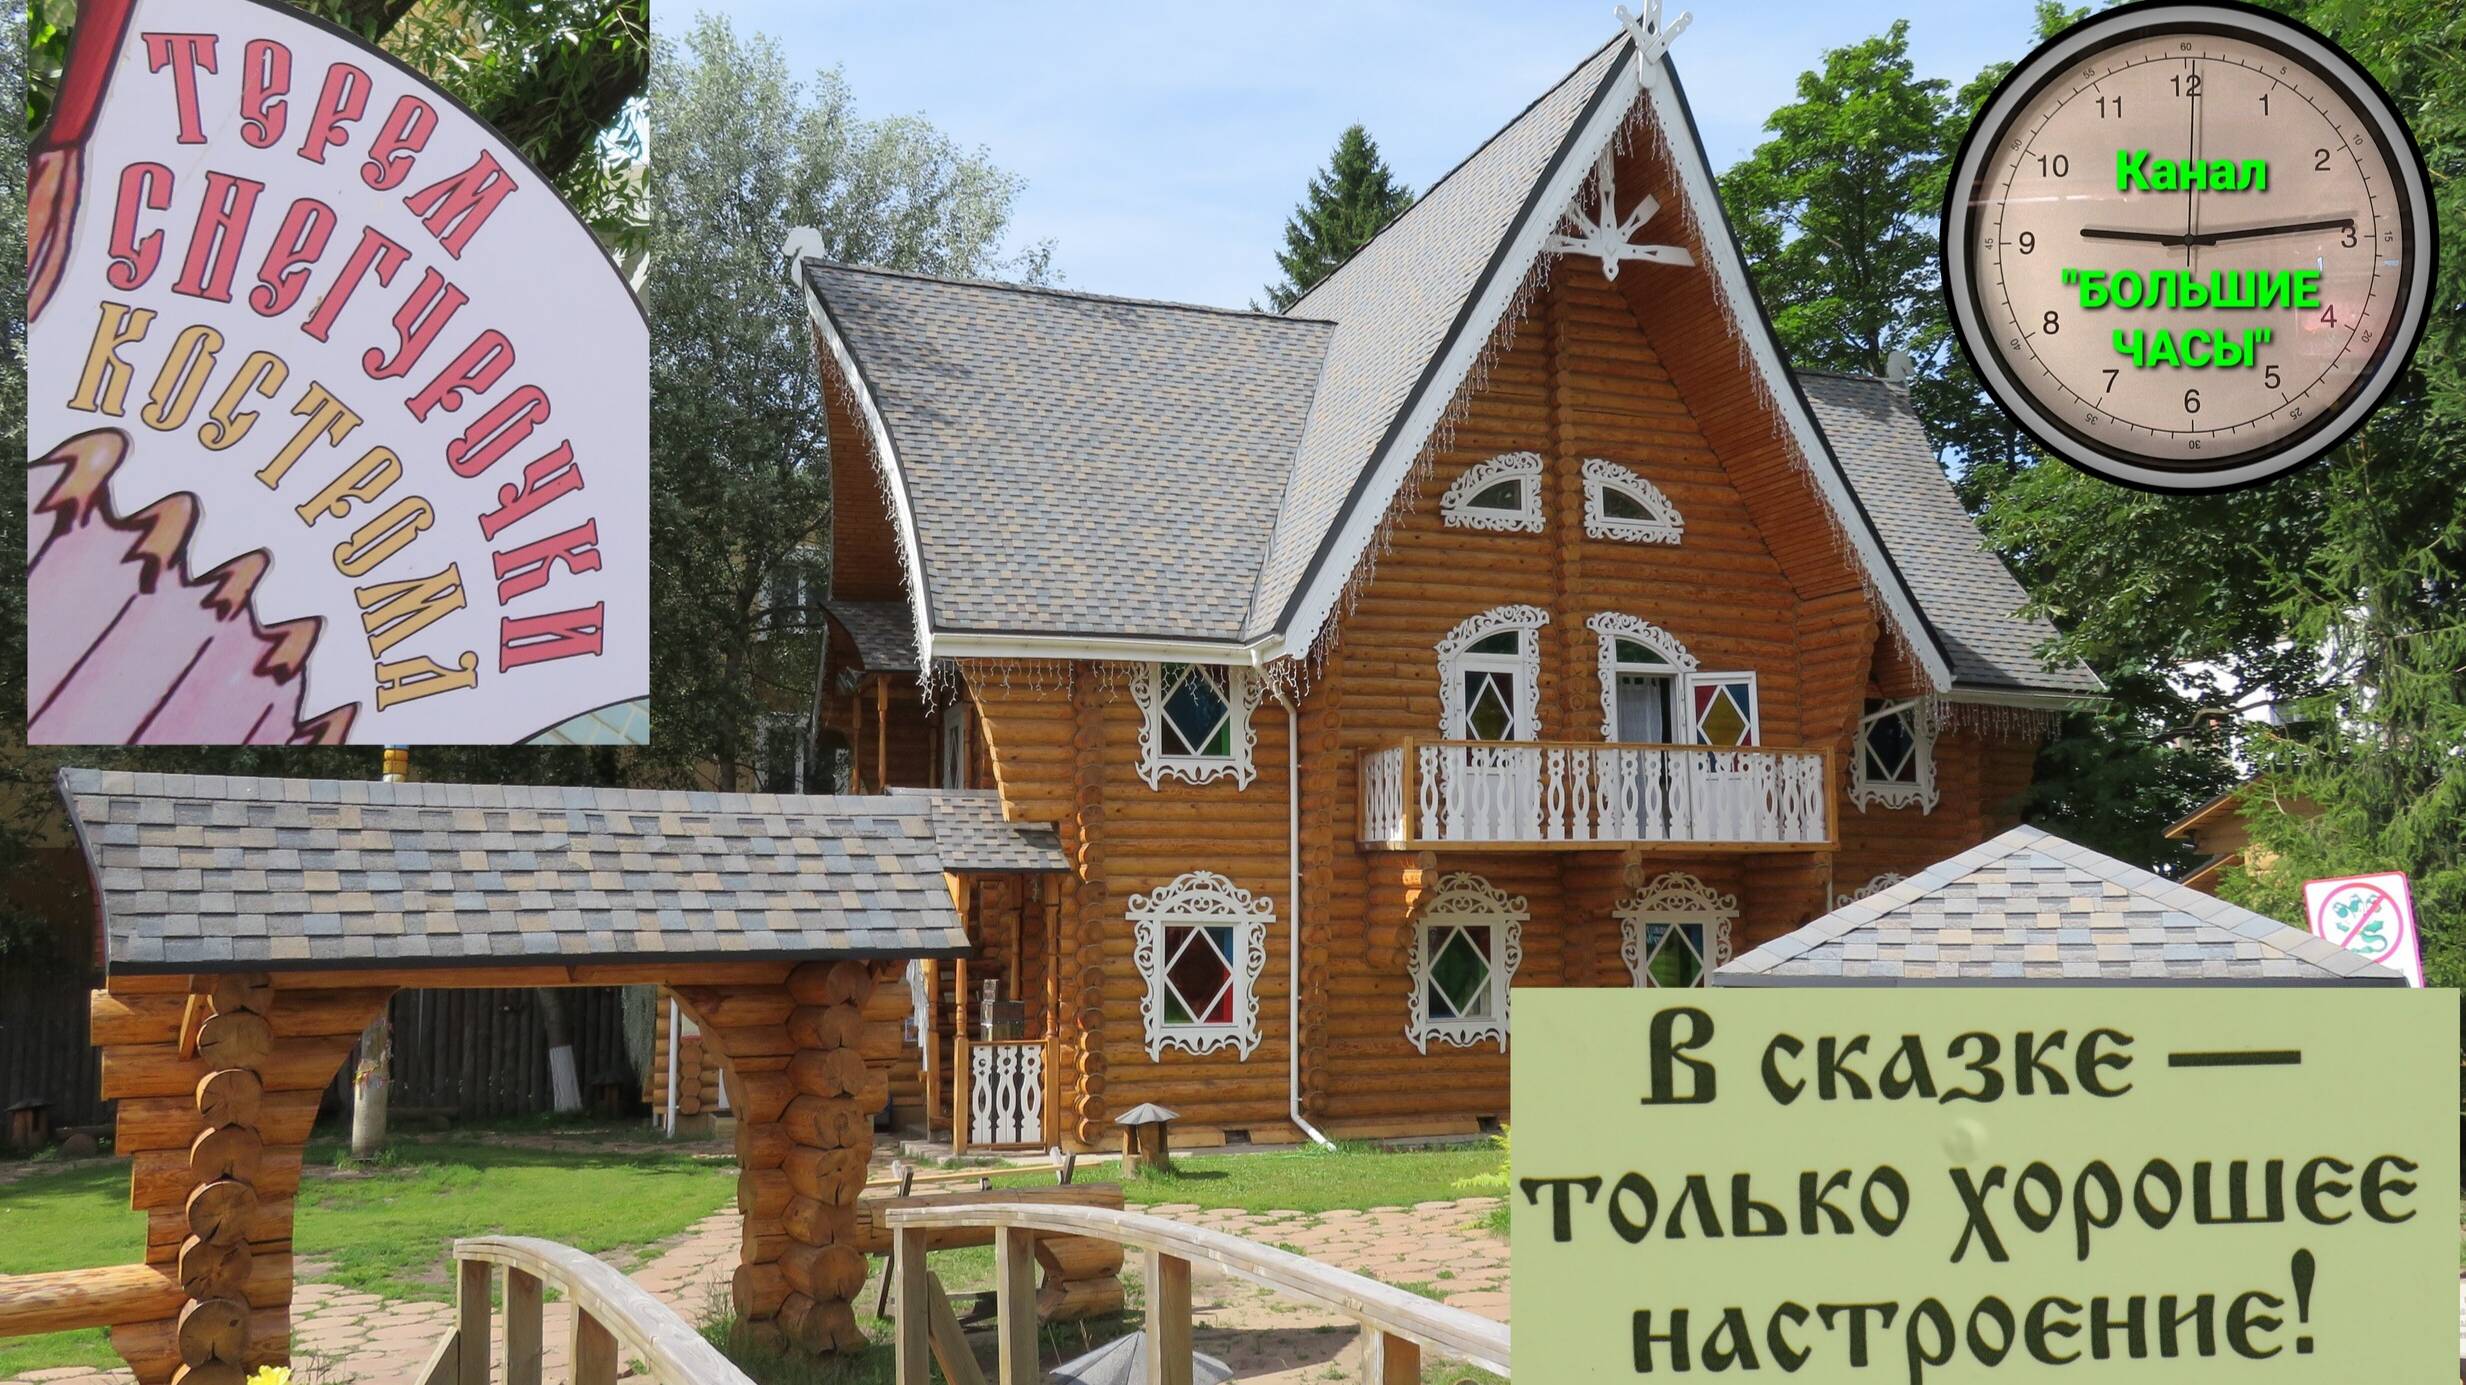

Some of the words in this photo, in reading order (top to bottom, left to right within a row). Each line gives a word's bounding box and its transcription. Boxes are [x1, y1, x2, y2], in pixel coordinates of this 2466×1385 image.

[2180, 42, 2192, 51] 60
[2082, 69, 2096, 79] 55
[2170, 74, 2202, 97] 12
[2096, 96, 2122, 118] 11
[2259, 94, 2269, 116] 1
[2011, 139, 2023, 151] 50
[2352, 133, 2364, 146] 10
[2038, 155, 2069, 177] 10
[2314, 149, 2331, 171] 2
[1984, 238, 1993, 250] 45
[2019, 232, 2035, 254] 9
[2341, 225, 2357, 248] 3
[2384, 230, 2393, 242] 15
[2043, 311, 2060, 334] 8
[2320, 304, 2337, 328] 4
[2010, 338, 2021, 351] 40
[2361, 329, 2372, 343] 20
[2102, 369, 2119, 393] 7
[2264, 365, 2281, 389] 5
[2184, 389, 2201, 413] 6
[2084, 413, 2098, 424] 35
[2289, 407, 2303, 420] 25
[2189, 439, 2201, 450] 30
[1641, 1006, 1718, 1105] В
[1761, 1028, 2135, 1106] сказке
[1519, 1165, 1910, 1244] только
[1632, 1248, 2316, 1385] настроение!
